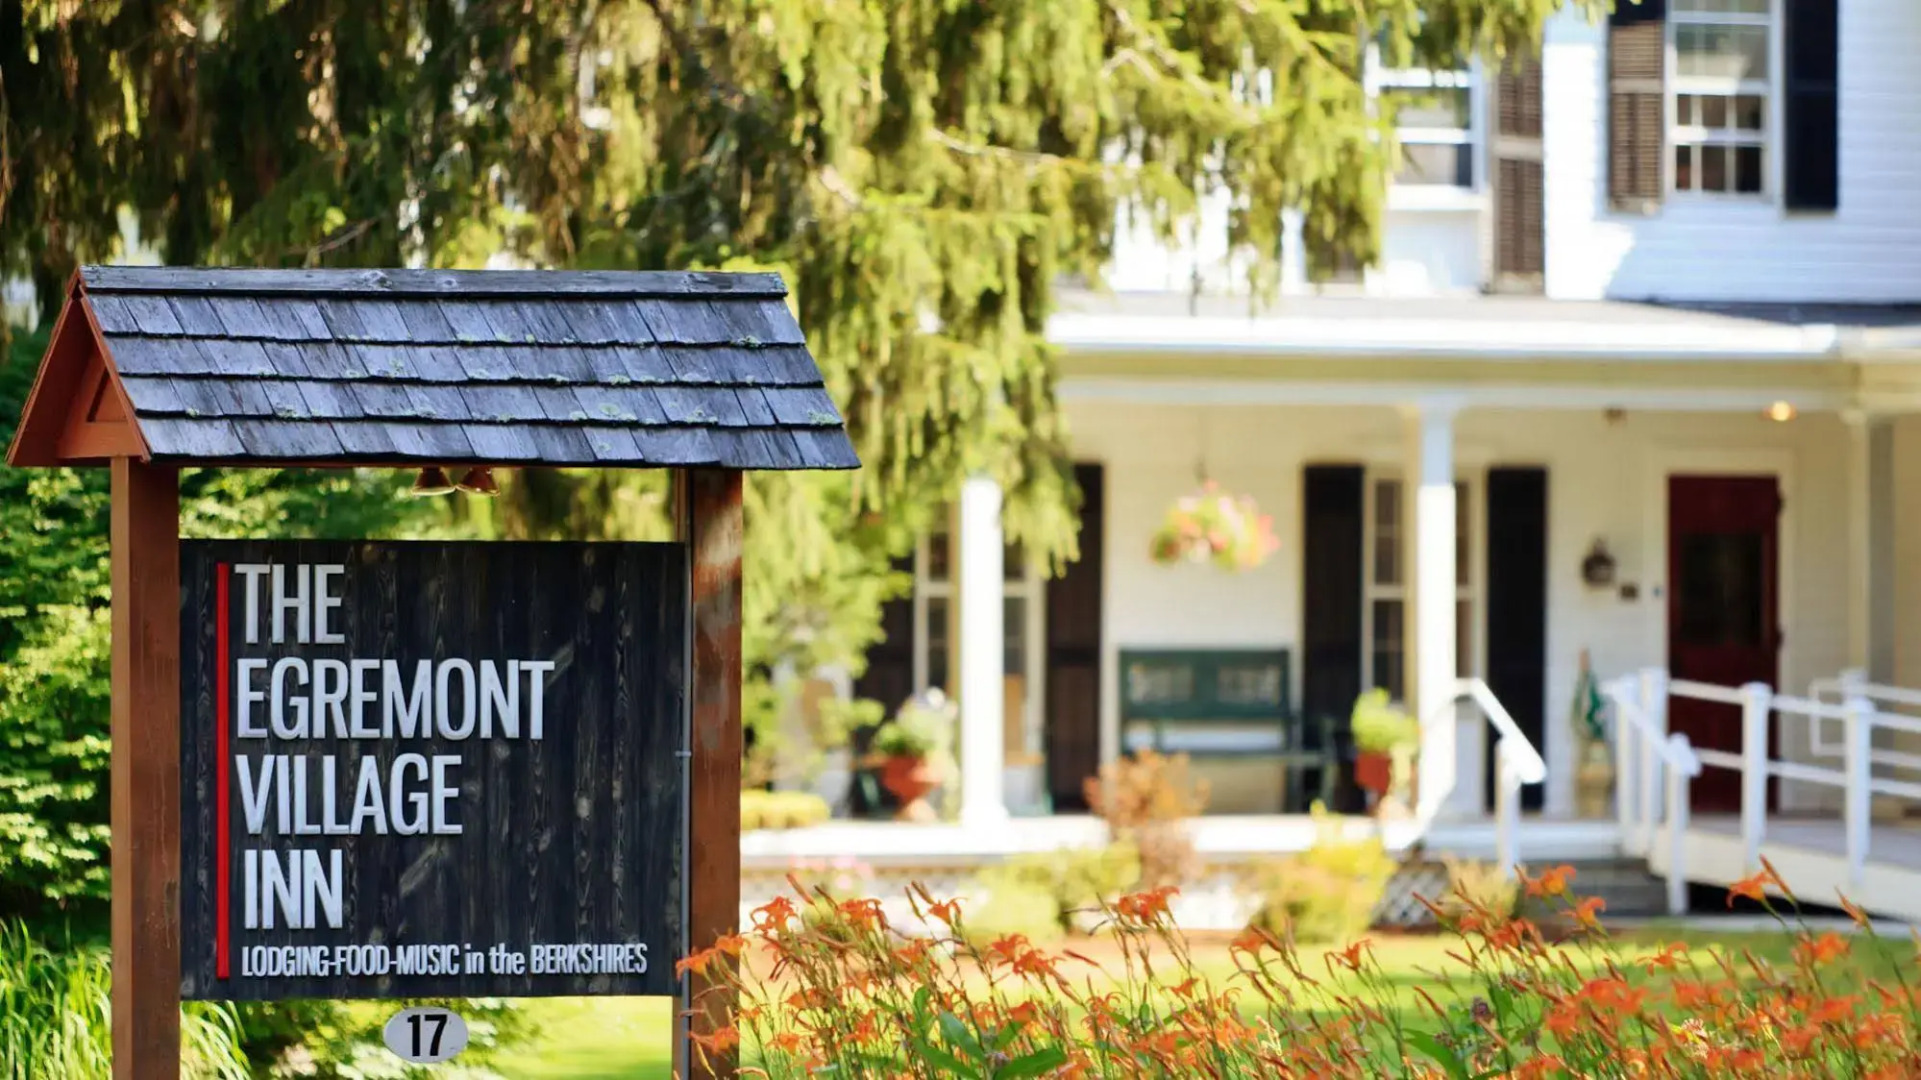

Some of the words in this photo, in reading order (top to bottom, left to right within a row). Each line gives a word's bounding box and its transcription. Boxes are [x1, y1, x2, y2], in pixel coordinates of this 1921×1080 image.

[234, 563, 345, 645] THE
[236, 657, 555, 741] EGREMONT
[234, 752, 463, 836] VILLAGE
[244, 848, 343, 930] INN
[241, 944, 460, 977] LODGING-FOOD-MUSIC
[464, 942, 486, 974] in
[488, 942, 526, 975] the
[529, 943, 648, 975] BERKSHIRES
[405, 1013, 449, 1057] 17
